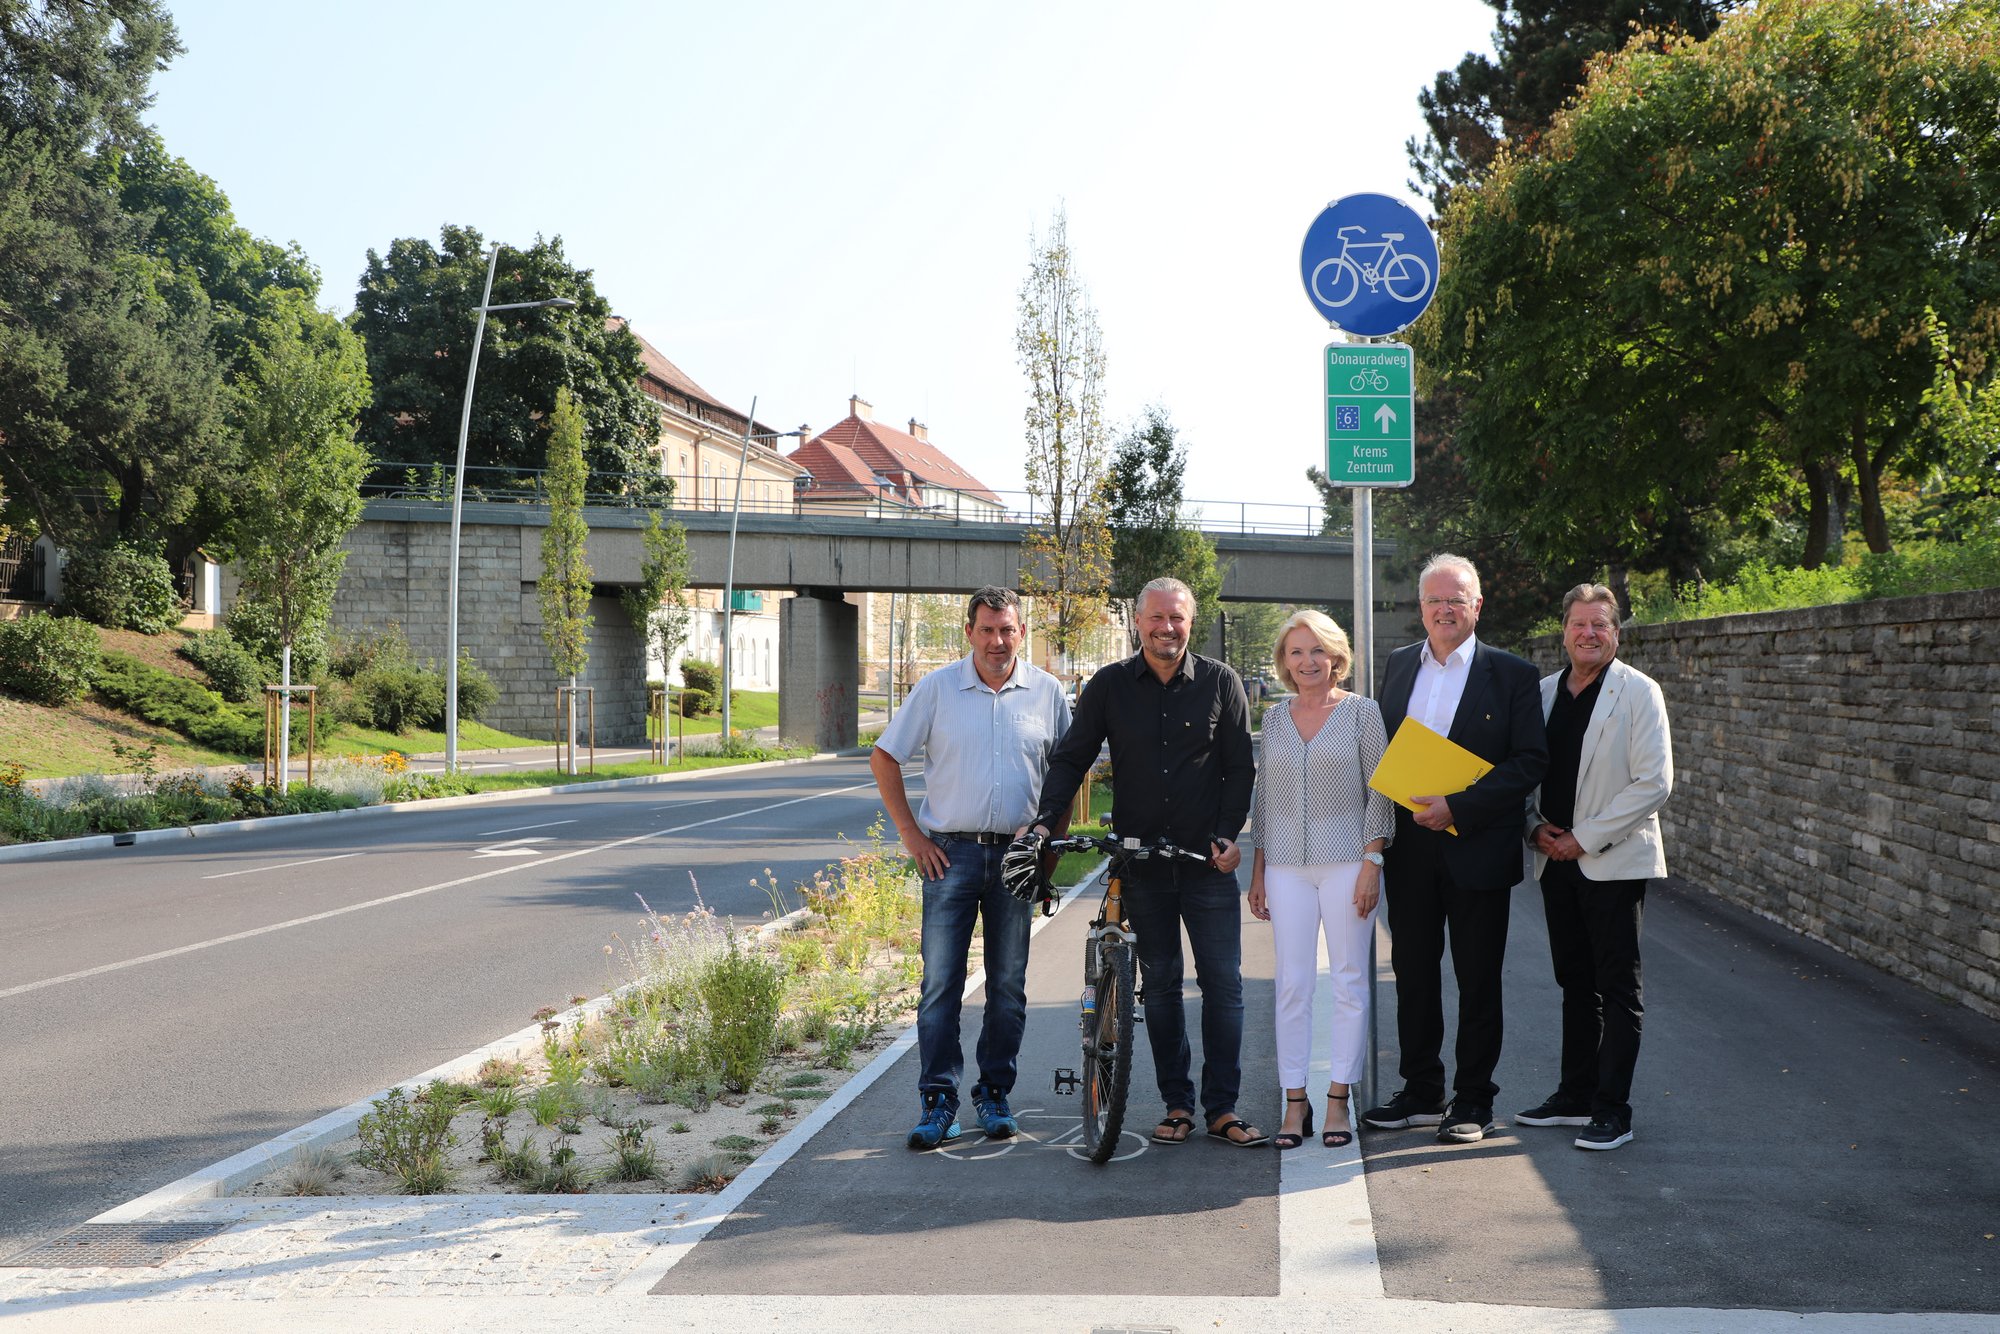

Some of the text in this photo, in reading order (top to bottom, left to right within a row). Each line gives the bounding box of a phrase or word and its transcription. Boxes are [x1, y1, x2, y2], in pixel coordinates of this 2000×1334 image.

[1331, 352, 1407, 368] Donauradweg
[1344, 412, 1352, 425] 6
[1353, 445, 1388, 458] Krems
[1347, 461, 1394, 474] Zentrum
